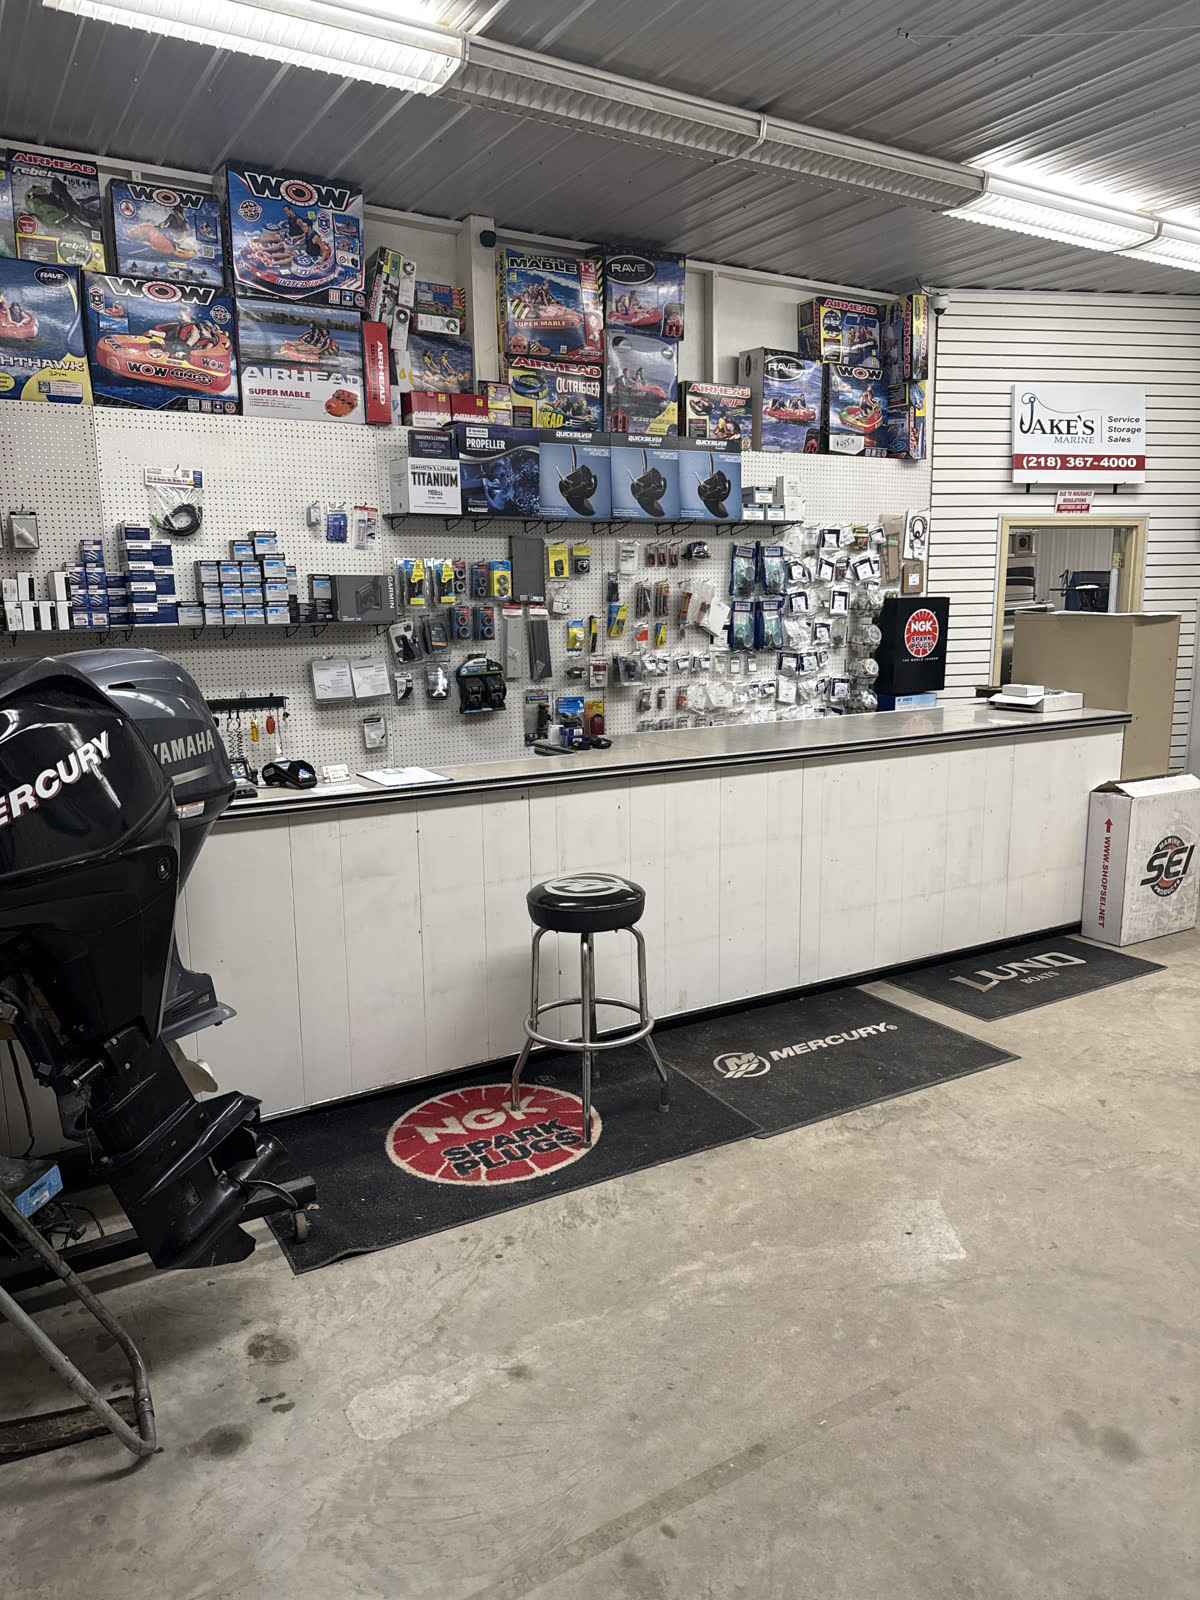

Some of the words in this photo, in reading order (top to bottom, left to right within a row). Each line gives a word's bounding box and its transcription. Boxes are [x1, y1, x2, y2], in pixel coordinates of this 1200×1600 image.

[12, 152, 97, 175] AIRHEAD
[127, 183, 204, 209] WOW
[245, 172, 350, 211] WOW
[508, 257, 577, 274] MABLE
[611, 263, 646, 273] RAVE
[39, 271, 65, 280] RAVE
[104, 276, 215, 305] WOW
[824, 298, 877, 315] AIRHEAD
[904, 300, 912, 379] AIRHEAD
[127, 361, 168, 377] WOW
[241, 366, 364, 385] AIRHEAD
[377, 340, 386, 405] AIRHEAD
[512, 356, 602, 378] AIRHEAD
[767, 362, 798, 372] RAVE
[837, 365, 883, 380] WOW
[248, 387, 279, 396] SUPER
[280, 389, 311, 398] MABLE
[555, 376, 601, 398] OUTRIGGER
[1020, 395, 1095, 436] JAKE'S
[1107, 415, 1140, 424] Service
[555, 430, 593, 439] QUICKSILVER
[628, 434, 663, 444] QUICKSILVER
[1107, 426, 1142, 435] Storage
[466, 438, 506, 449] PROPELLER
[696, 438, 728, 447] QUICKSILVER
[1054, 436, 1095, 444] MARINE
[1023, 456, 1061, 469] (218)
[1066, 456, 1137, 468] 367-4000
[411, 472, 458, 487] TITANIUM
[387, 575, 395, 609] GARMIN
[911, 620, 933, 632] NGK
[1158, 836, 1182, 850] MARINE
[1140, 845, 1195, 886] SEI
[1098, 836, 1111, 928] WWW.SHOPSEI.NET
[1154, 878, 1181, 896] PRODUCTS
[948, 951, 1087, 993] LUND
[1019, 970, 1060, 984] BOATS
[414, 1095, 549, 1144] NGK
[443, 1117, 570, 1162] SPARK
[450, 1130, 583, 1177] PLUGS
